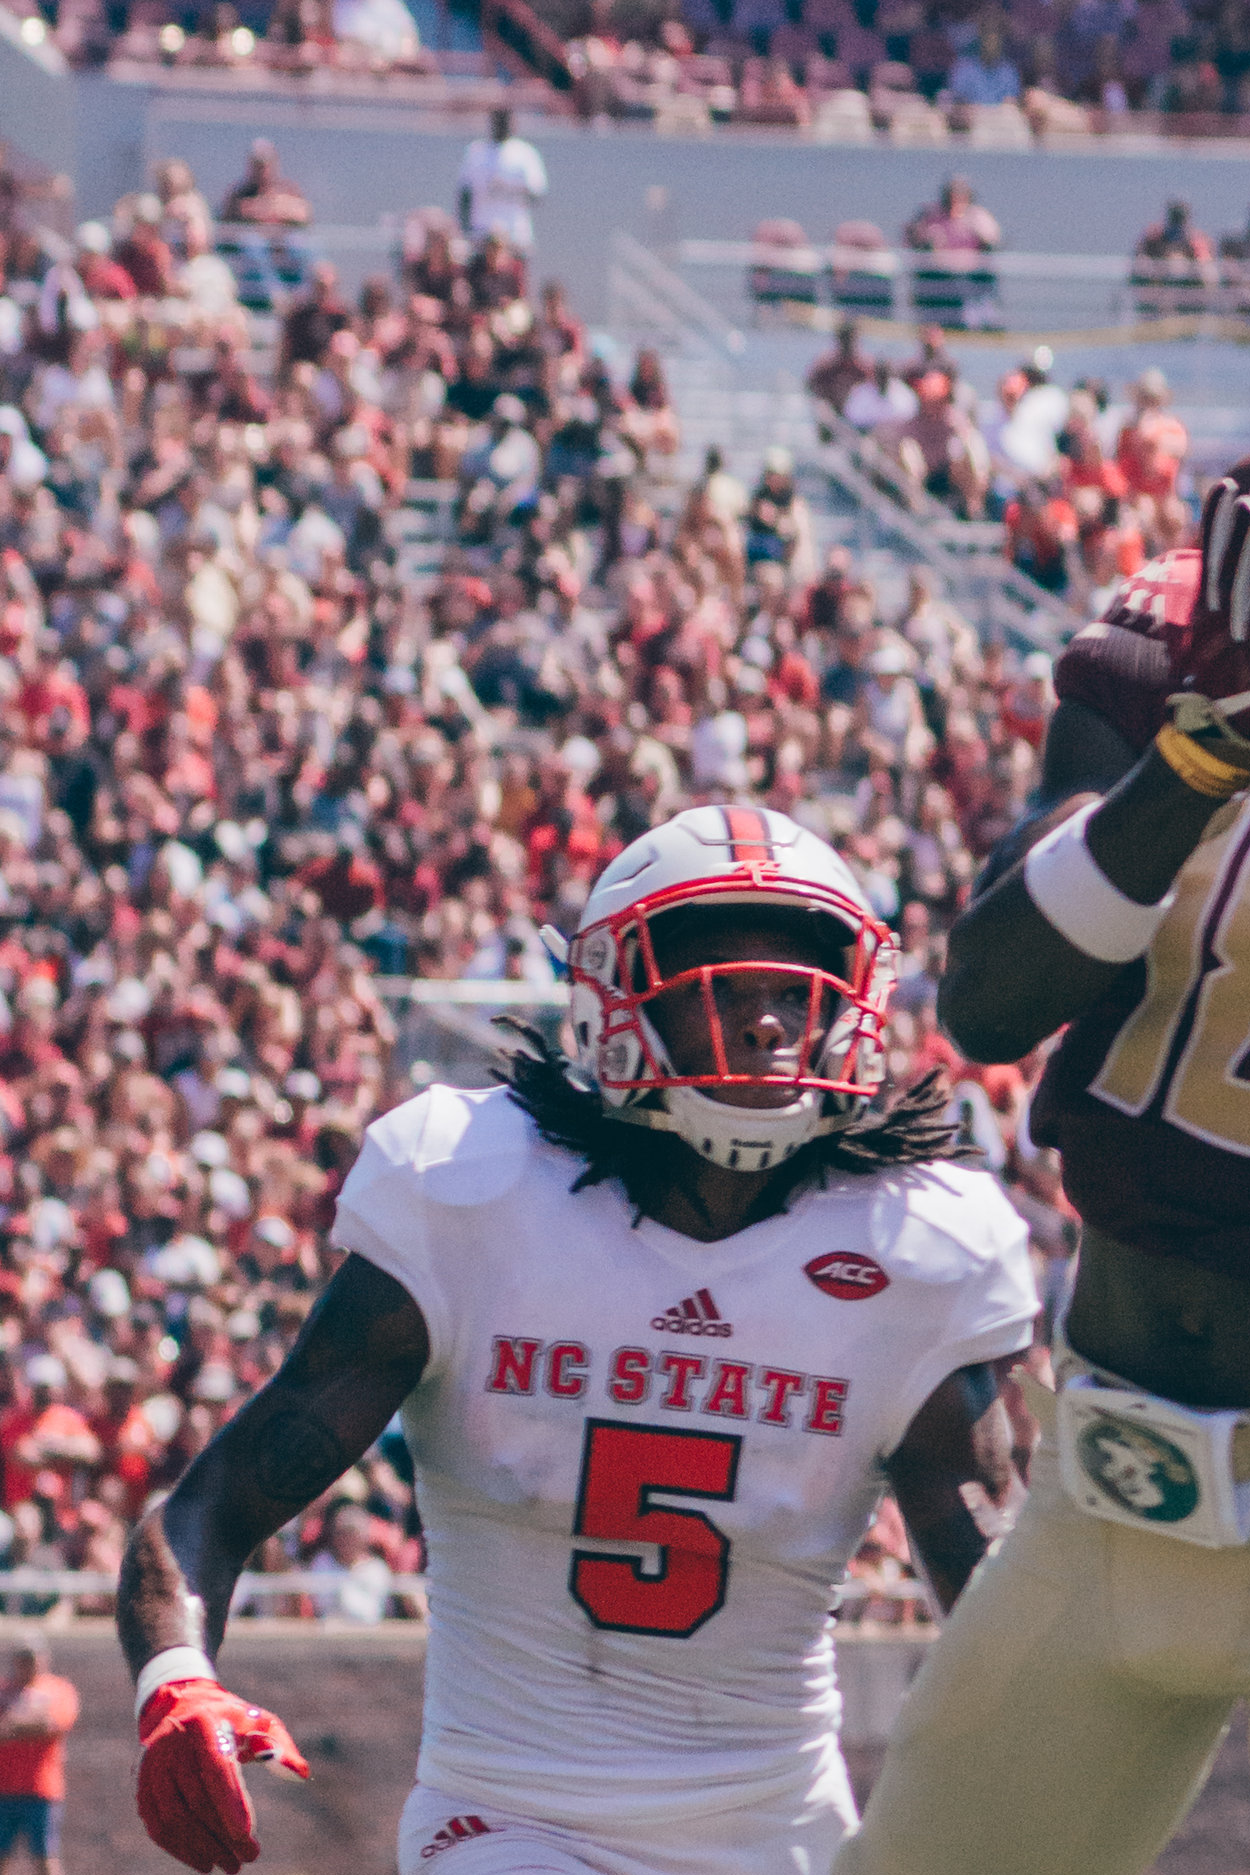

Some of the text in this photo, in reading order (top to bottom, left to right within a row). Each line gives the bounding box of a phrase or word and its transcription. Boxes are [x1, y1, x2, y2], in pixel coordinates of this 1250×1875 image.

[813, 1261, 879, 1284] ACC
[650, 1316, 733, 1338] adidas
[486, 1335, 849, 1436] NC STATE
[570, 1417, 743, 1638] 5
